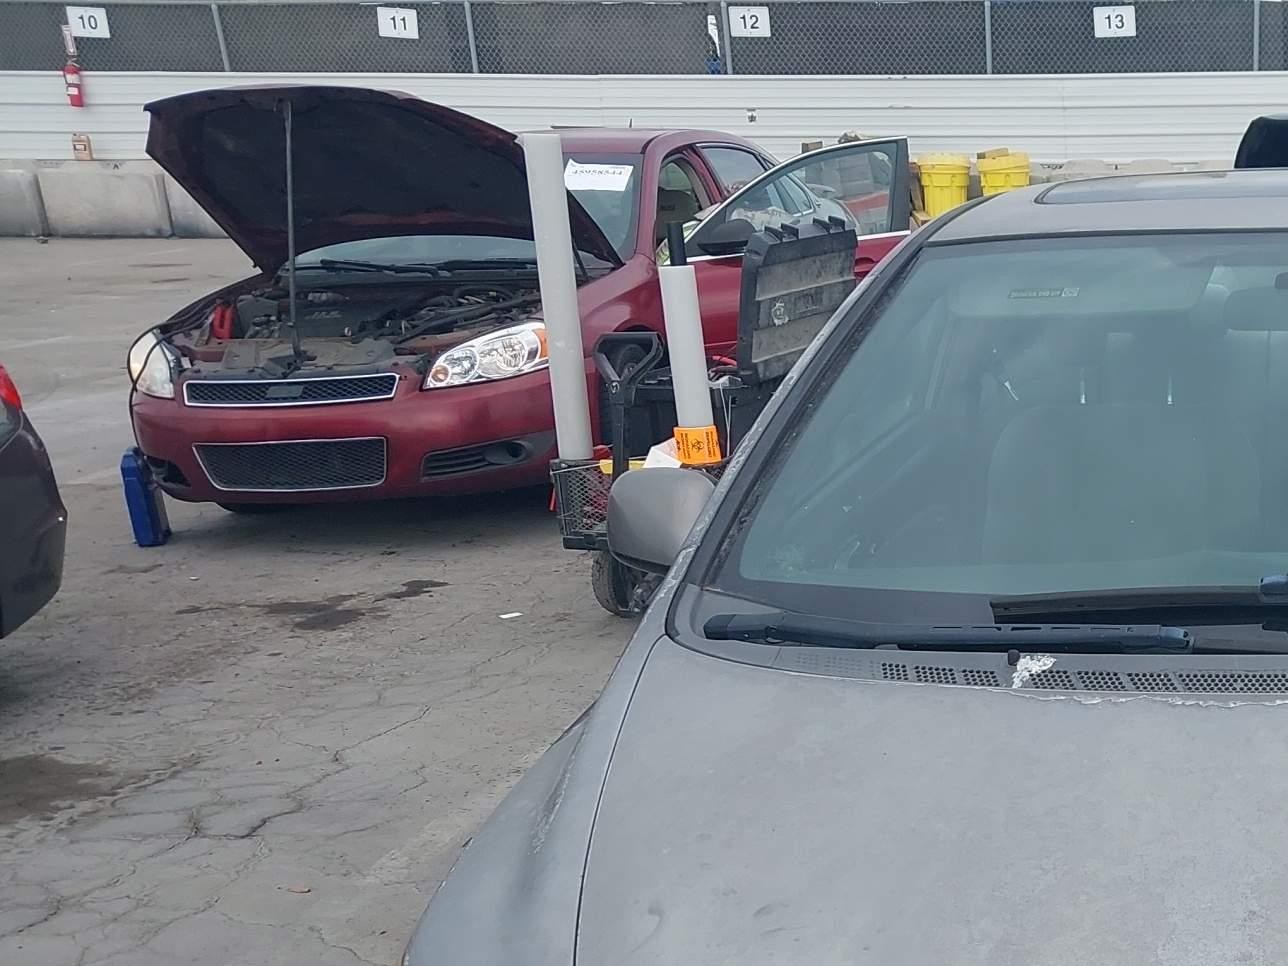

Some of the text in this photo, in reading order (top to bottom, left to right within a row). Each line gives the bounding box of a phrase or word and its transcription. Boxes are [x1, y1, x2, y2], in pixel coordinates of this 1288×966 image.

[78, 14, 98, 30] 10
[390, 15, 407, 31] 11
[740, 14, 760, 30] 12
[1104, 14, 1125, 30] 13
